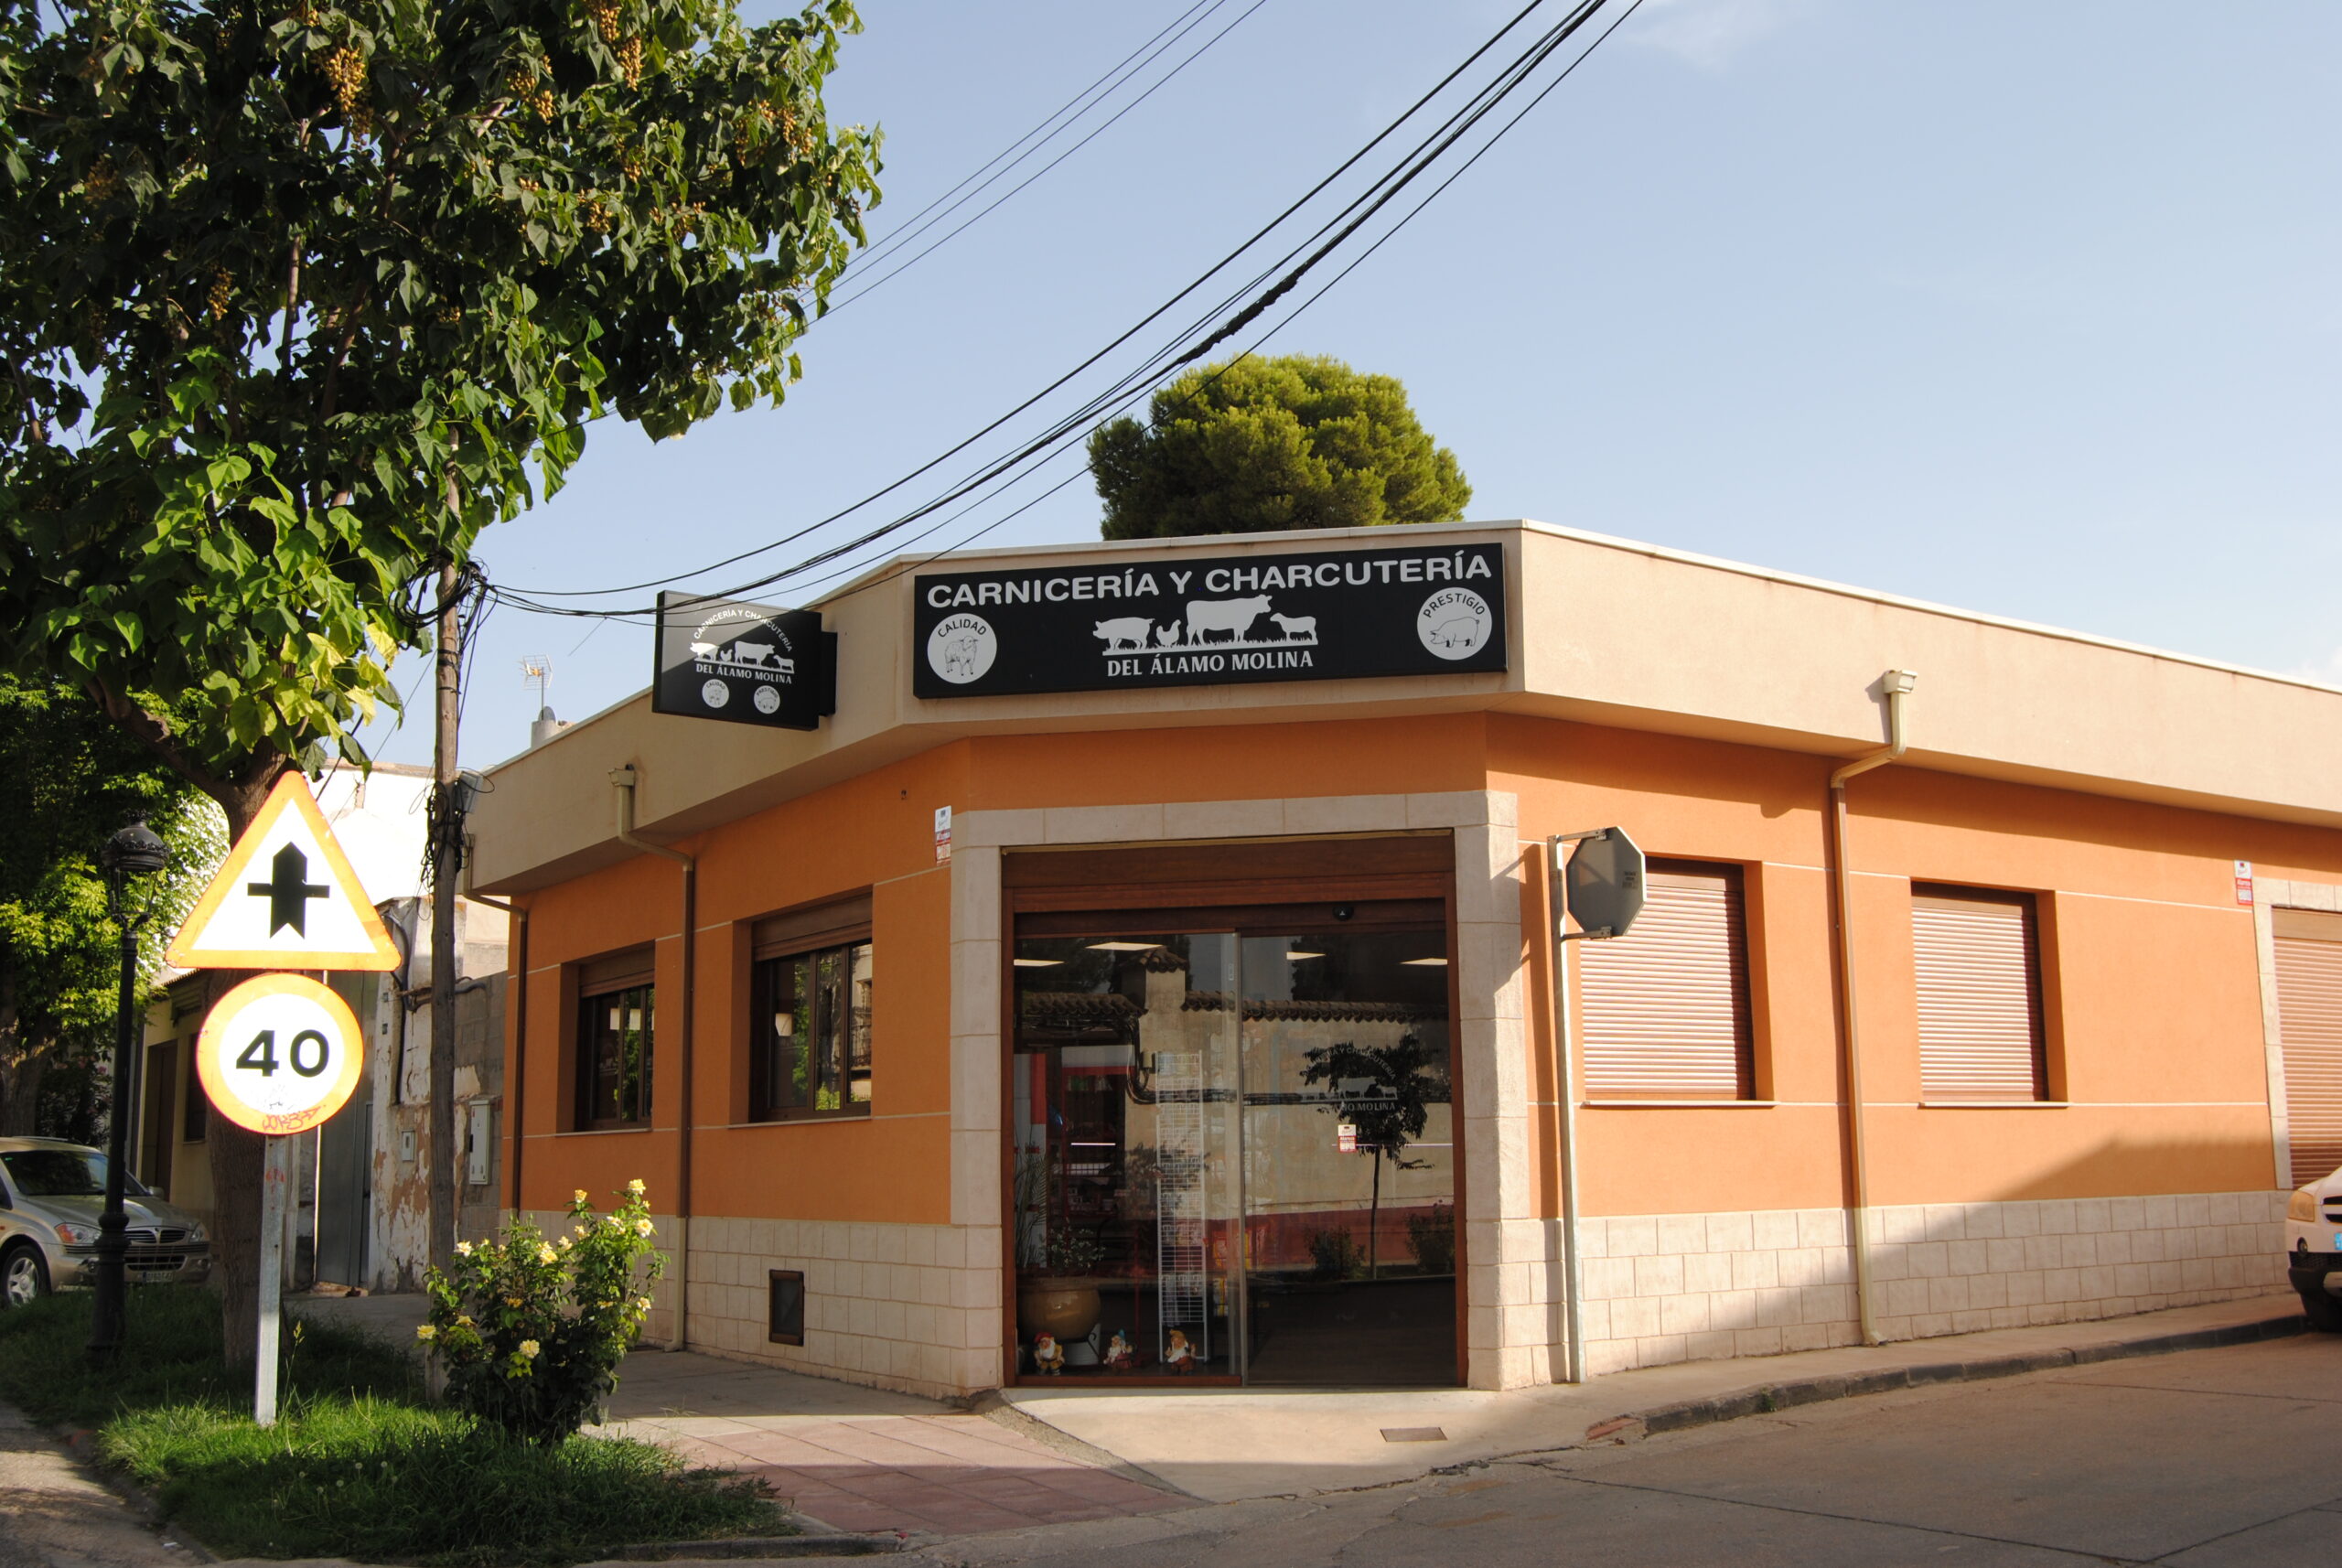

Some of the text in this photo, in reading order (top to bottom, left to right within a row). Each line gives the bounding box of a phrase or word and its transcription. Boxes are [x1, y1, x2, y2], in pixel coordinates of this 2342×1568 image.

[927, 550, 1492, 607] CARNICERÍA Y CHARCUTERÍA
[1423, 593, 1486, 618] PRESTIGIO
[693, 609, 736, 639] CARNICERÍA
[745, 611, 793, 652] CHARCUTERÍA
[938, 618, 987, 638] CALIDAD
[696, 663, 792, 684] DEL ÁLAMO MOLINA
[1107, 650, 1314, 677] DEL ÁLAMO MOLINA
[236, 1029, 330, 1078] 40
